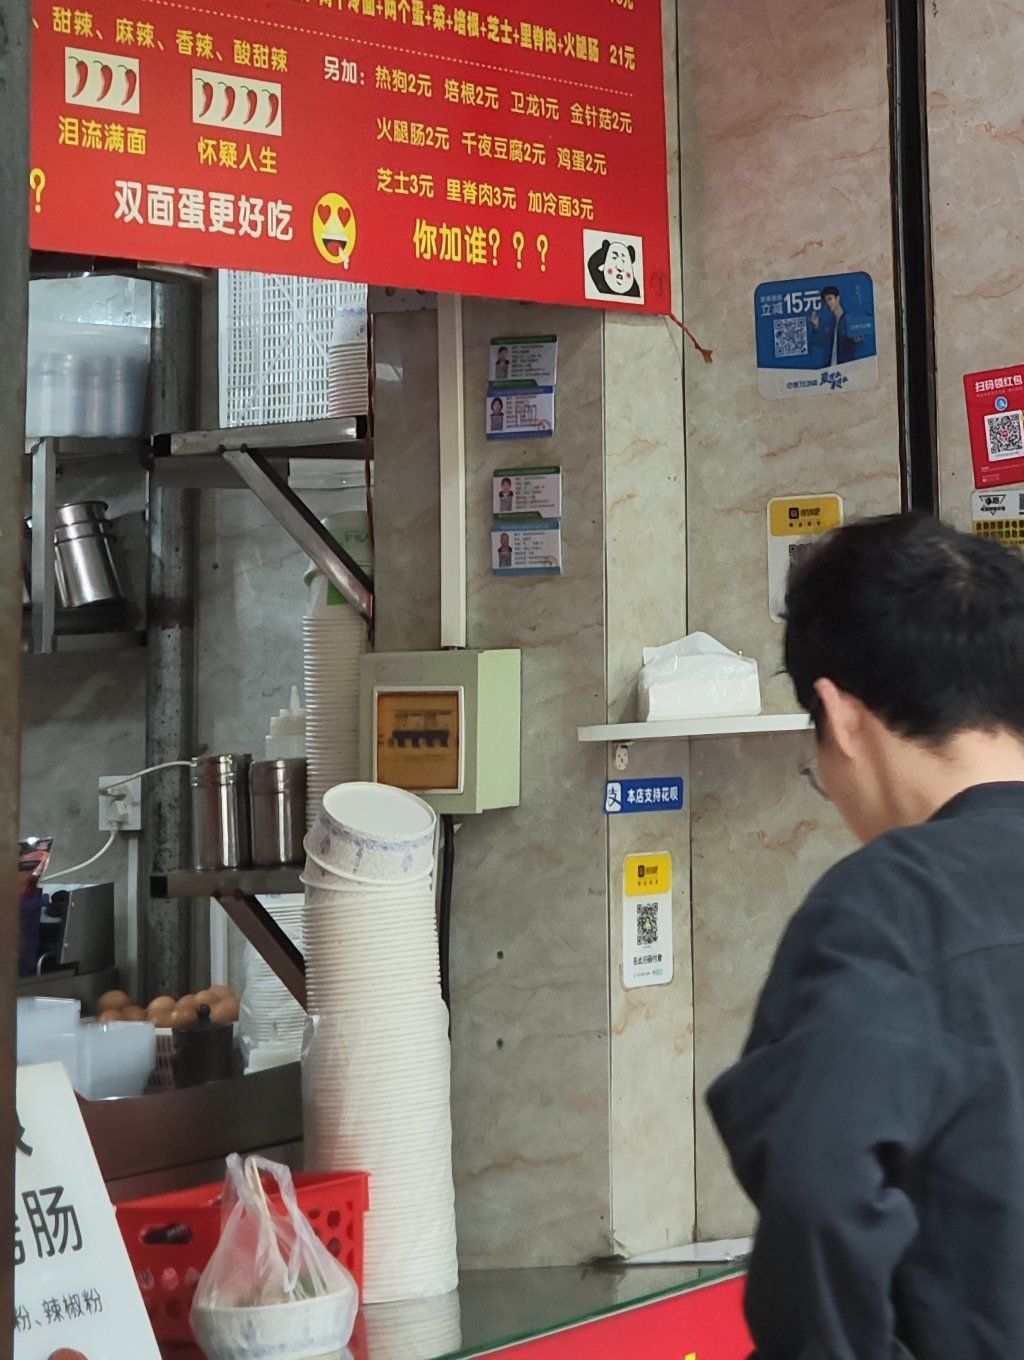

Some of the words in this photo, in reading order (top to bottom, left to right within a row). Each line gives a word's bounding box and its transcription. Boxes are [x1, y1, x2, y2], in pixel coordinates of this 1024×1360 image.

[609, 44, 636, 71] 21元
[375, 65, 432, 98] 热狗2元
[444, 78, 499, 110] 培根2元
[510, 90, 560, 121] 卫龙1元
[570, 102, 633, 134] 金针菇2元
[58, 115, 147, 156] 泪流满面
[197, 136, 278, 174] 怀疑人生
[376, 116, 450, 151] 火腿肠2元
[461, 131, 546, 166] 千夜豆腐2元
[557, 146, 607, 176] 鸡蛋2元
[114, 179, 293, 241] 双面蛋更好吃
[377, 167, 434, 199] 芝士3元
[446, 178, 517, 210] 里脊肉3元
[528, 190, 594, 221] 加冷面3元
